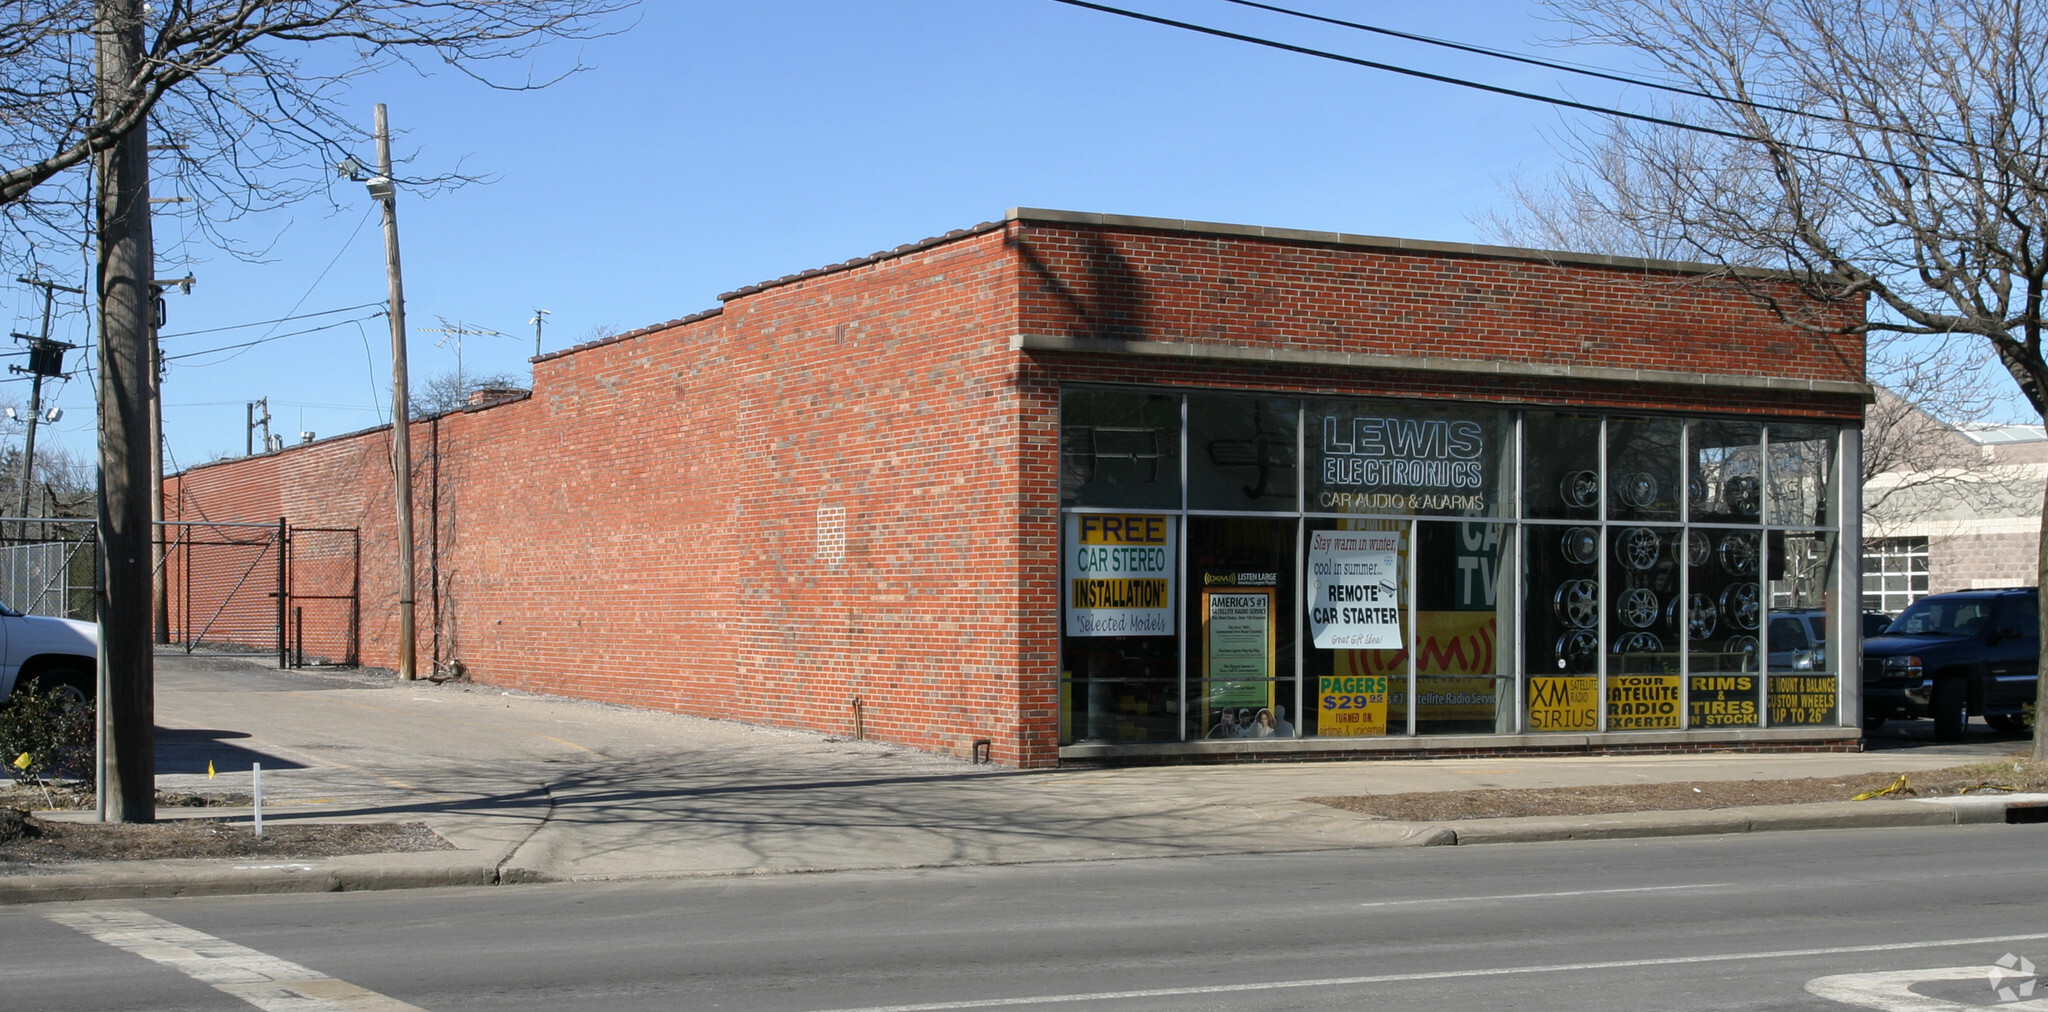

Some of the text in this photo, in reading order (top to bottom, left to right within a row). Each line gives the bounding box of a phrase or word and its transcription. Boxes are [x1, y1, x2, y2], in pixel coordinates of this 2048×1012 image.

[1323, 415, 1483, 459] LEWIS
[1323, 458, 1482, 488] ELECTRONICS
[1320, 491, 1484, 511] CAR AUDIO & ALARMS
[1081, 516, 1164, 542] FREE
[1313, 533, 1397, 555] Stay warm in winter,
[1078, 547, 1165, 572] CAR STEREO
[1313, 558, 1332, 576] cool
[1333, 562, 1343, 576] in
[1237, 572, 1277, 581] LISTEN LARGE
[1328, 584, 1379, 602] REMOTE
[1211, 596, 1266, 608] AMERICA'S #1
[1130, 612, 1167, 632] Models
[1313, 607, 1398, 624] CAR STARTER
[1331, 633, 1384, 646] Great Gift Idea!
[1320, 677, 1387, 694] PAGERS
[1619, 677, 1664, 686] YOUR
[1691, 676, 1752, 691] RIMS
[1776, 677, 1798, 692] MOUNT
[1799, 677, 1805, 692] &
[1806, 677, 1836, 692] BALANCE
[1445, 691, 1469, 704] Radio
[1530, 679, 1598, 707] XM SATELLITE
[1570, 691, 1588, 703] RADIO
[1717, 691, 1725, 700] &
[1323, 694, 1367, 711] $29
[1607, 701, 1675, 716] RADIO
[1690, 701, 1755, 715] TIRES
[1767, 694, 1835, 708] CUSTOM WHEELS
[1335, 712, 1360, 723] TURNED
[1530, 709, 1596, 728] SIRIUS
[1607, 716, 1677, 728] EXPERTS!
[1706, 713, 1758, 725] STOCK!
[1773, 707, 1828, 723] UP TO 26"
